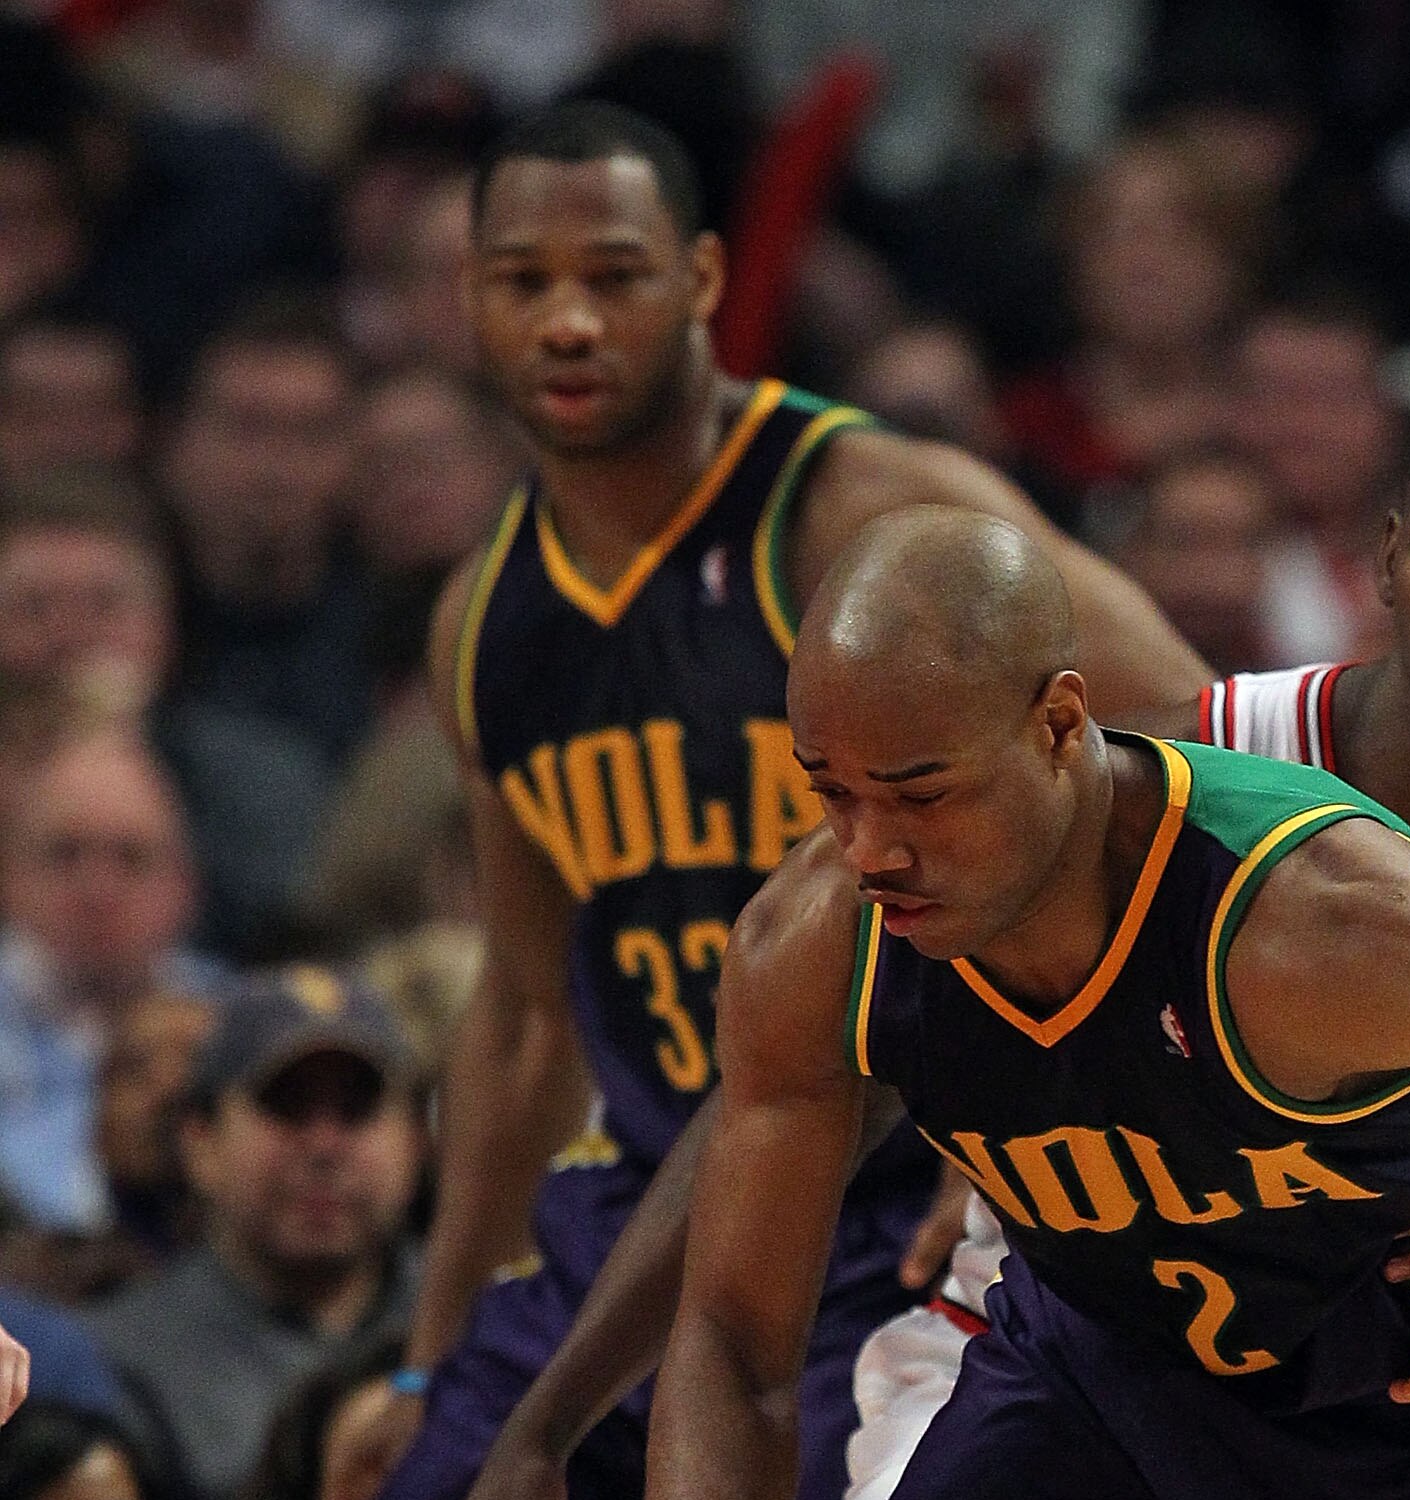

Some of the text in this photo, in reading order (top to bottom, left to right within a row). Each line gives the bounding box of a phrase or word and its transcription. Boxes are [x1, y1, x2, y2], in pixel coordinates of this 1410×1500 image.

[500, 717, 826, 898] NOLA
[614, 921, 730, 1092] 3
[915, 1125, 1384, 1233] NOLA
[1151, 1258, 1281, 1377] 2
